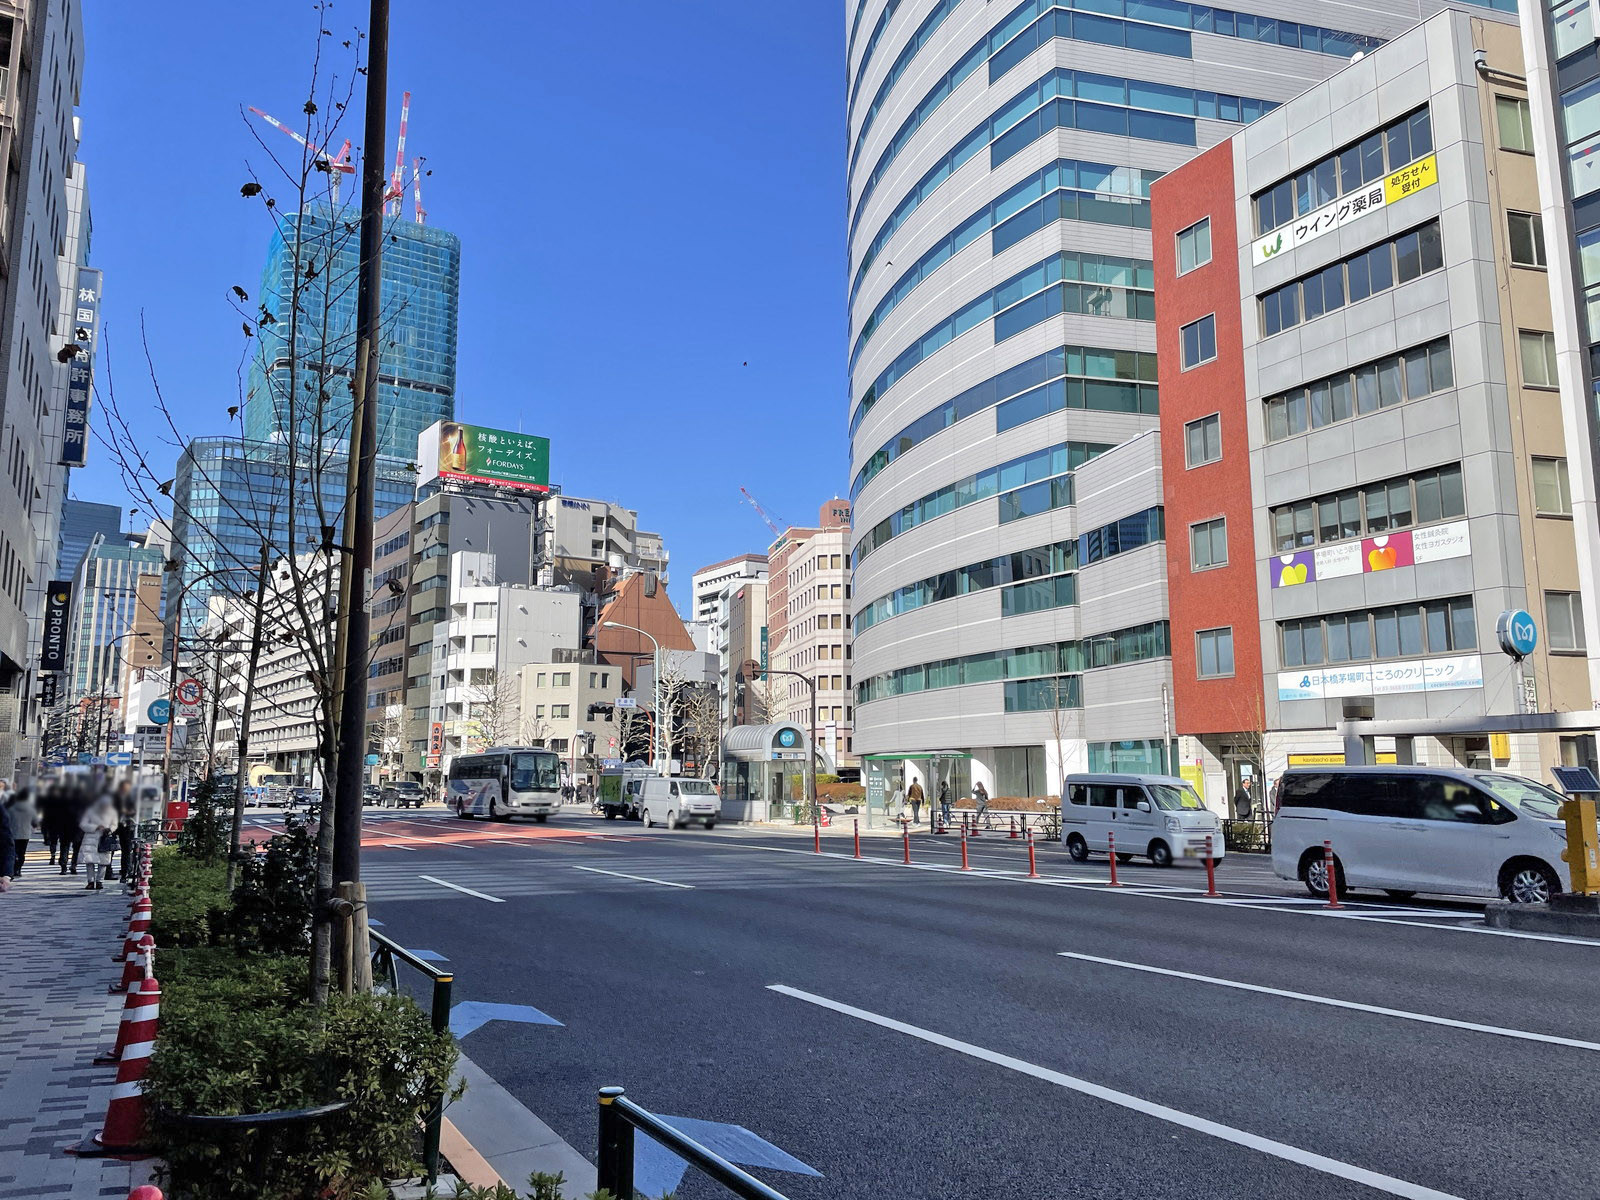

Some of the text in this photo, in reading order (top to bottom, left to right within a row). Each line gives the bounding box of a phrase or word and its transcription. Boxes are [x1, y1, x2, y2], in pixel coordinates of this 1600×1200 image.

[1391, 162, 1430, 187] 処方せん
[1402, 177, 1421, 194] 受付
[1295, 187, 1383, 240] ウイング薬局
[477, 432, 537, 450] 核酸といえば、
[478, 445, 537, 462] フォーデイズ。
[492, 459, 524, 470] FORDAYS
[48, 609, 63, 660] PRONTO
[1312, 664, 1455, 686] 日本橋茅場町こころのクリニック
